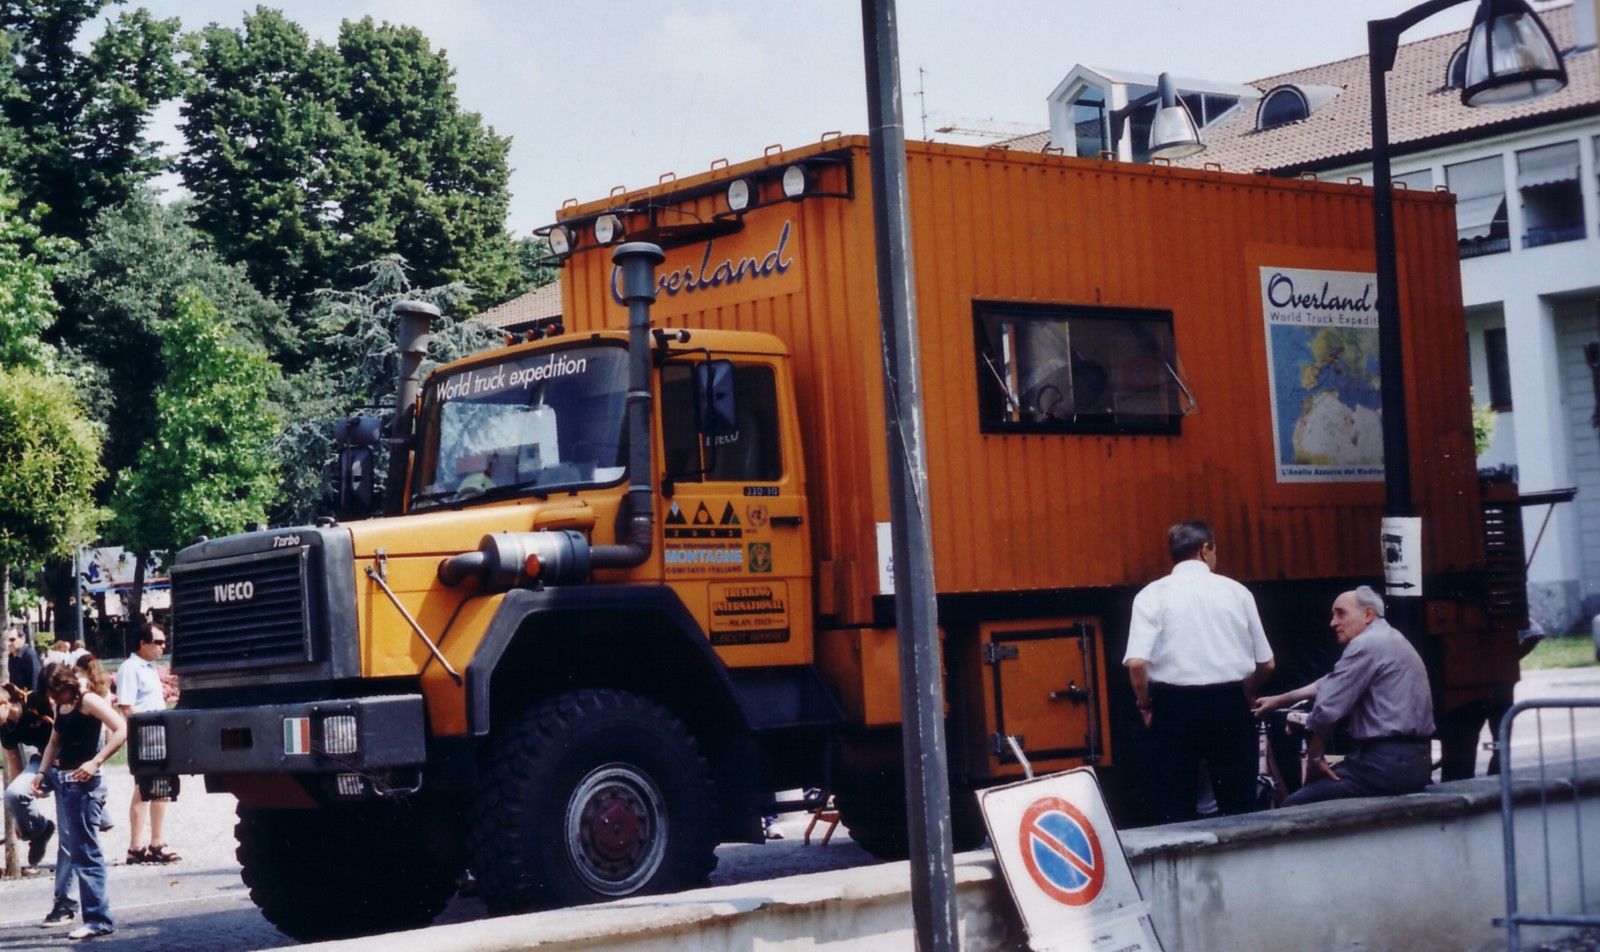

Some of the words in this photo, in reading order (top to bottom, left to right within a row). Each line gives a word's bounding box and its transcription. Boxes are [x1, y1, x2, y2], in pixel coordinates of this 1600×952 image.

[1267, 272, 1371, 312] Overland
[1270, 312, 1302, 322] World
[1307, 313, 1333, 324] Truck
[436, 371, 472, 402] World
[474, 364, 506, 394] truck
[509, 353, 587, 390] expedition
[273, 534, 300, 548] Turbo
[665, 549, 743, 564] MONTAGNE
[665, 566, 706, 574] COMITATO
[708, 565, 742, 573] ITALIANO
[214, 581, 254, 603] IVECO
[713, 601, 784, 614] INTERNATIONAL
